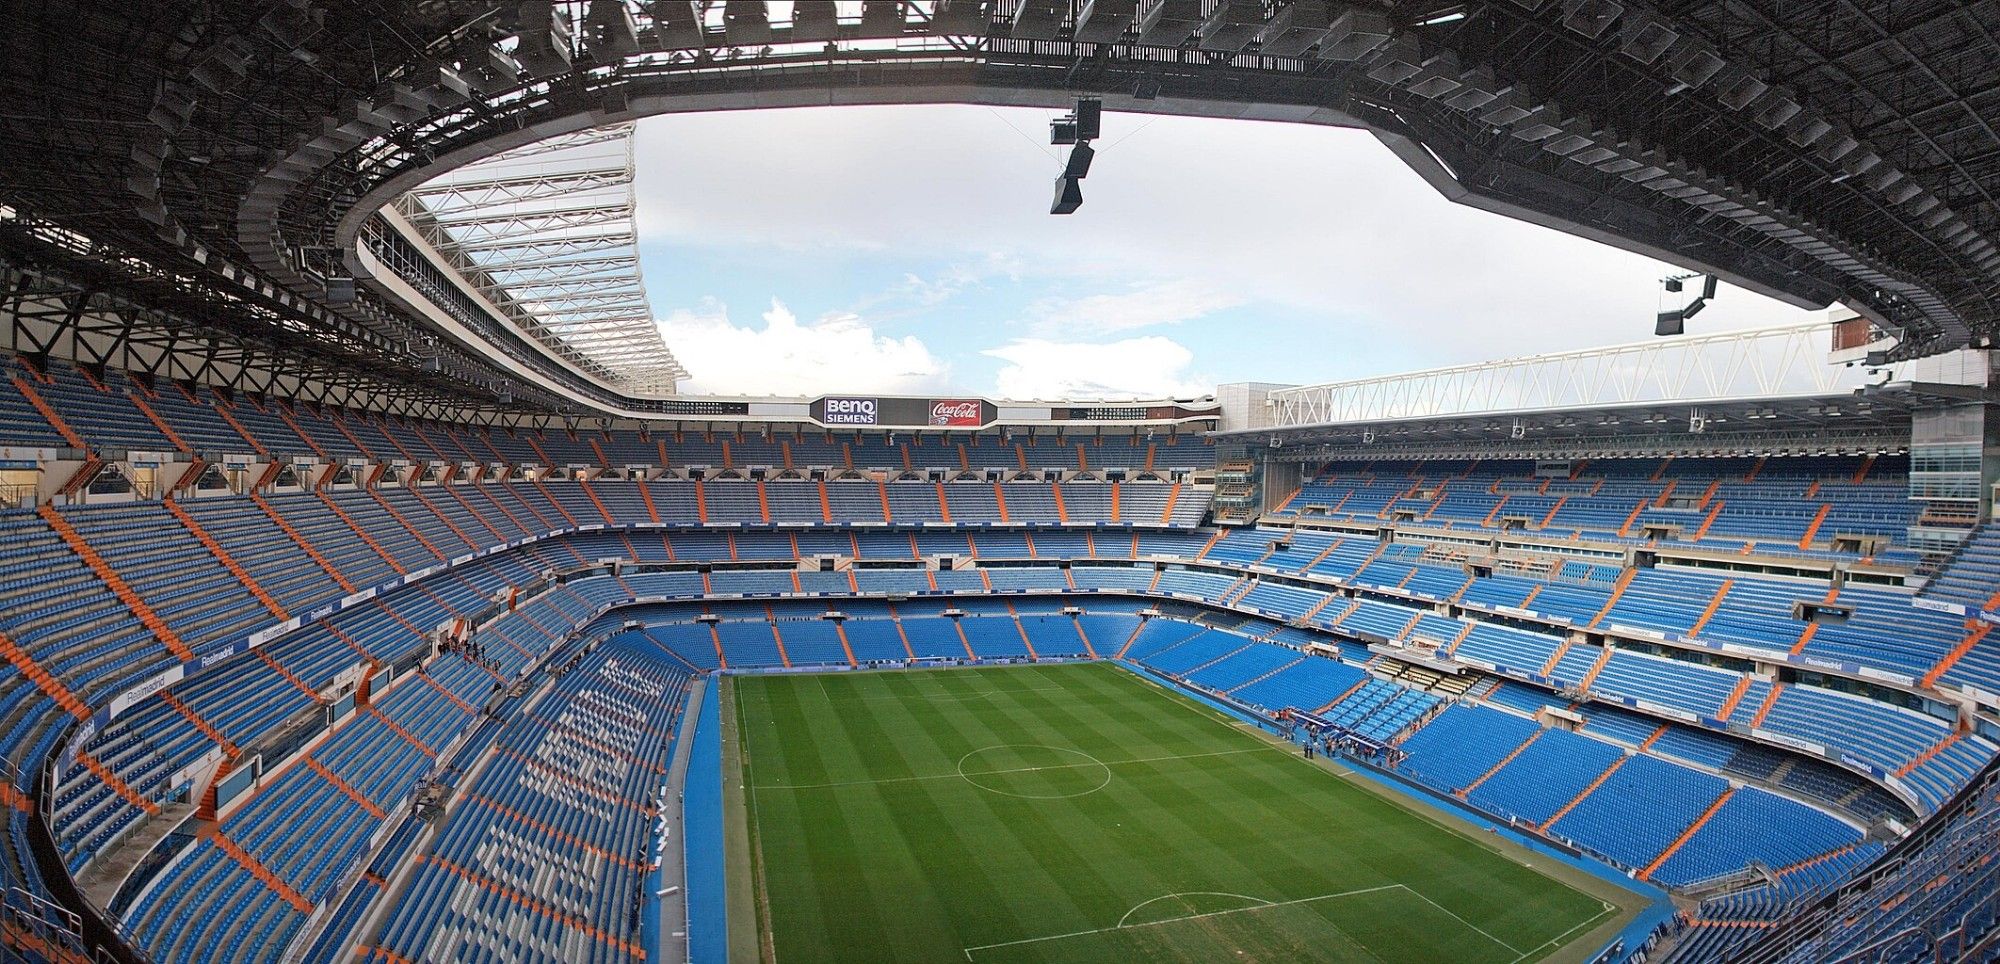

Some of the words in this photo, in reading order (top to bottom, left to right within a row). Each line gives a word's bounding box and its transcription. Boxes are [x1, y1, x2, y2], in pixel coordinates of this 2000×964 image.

[828, 414, 874, 423] SIEMENS
[201, 646, 234, 668] Realmadrid
[1804, 657, 1842, 671] Realmadrid
[127, 675, 165, 705] Realmadrid
